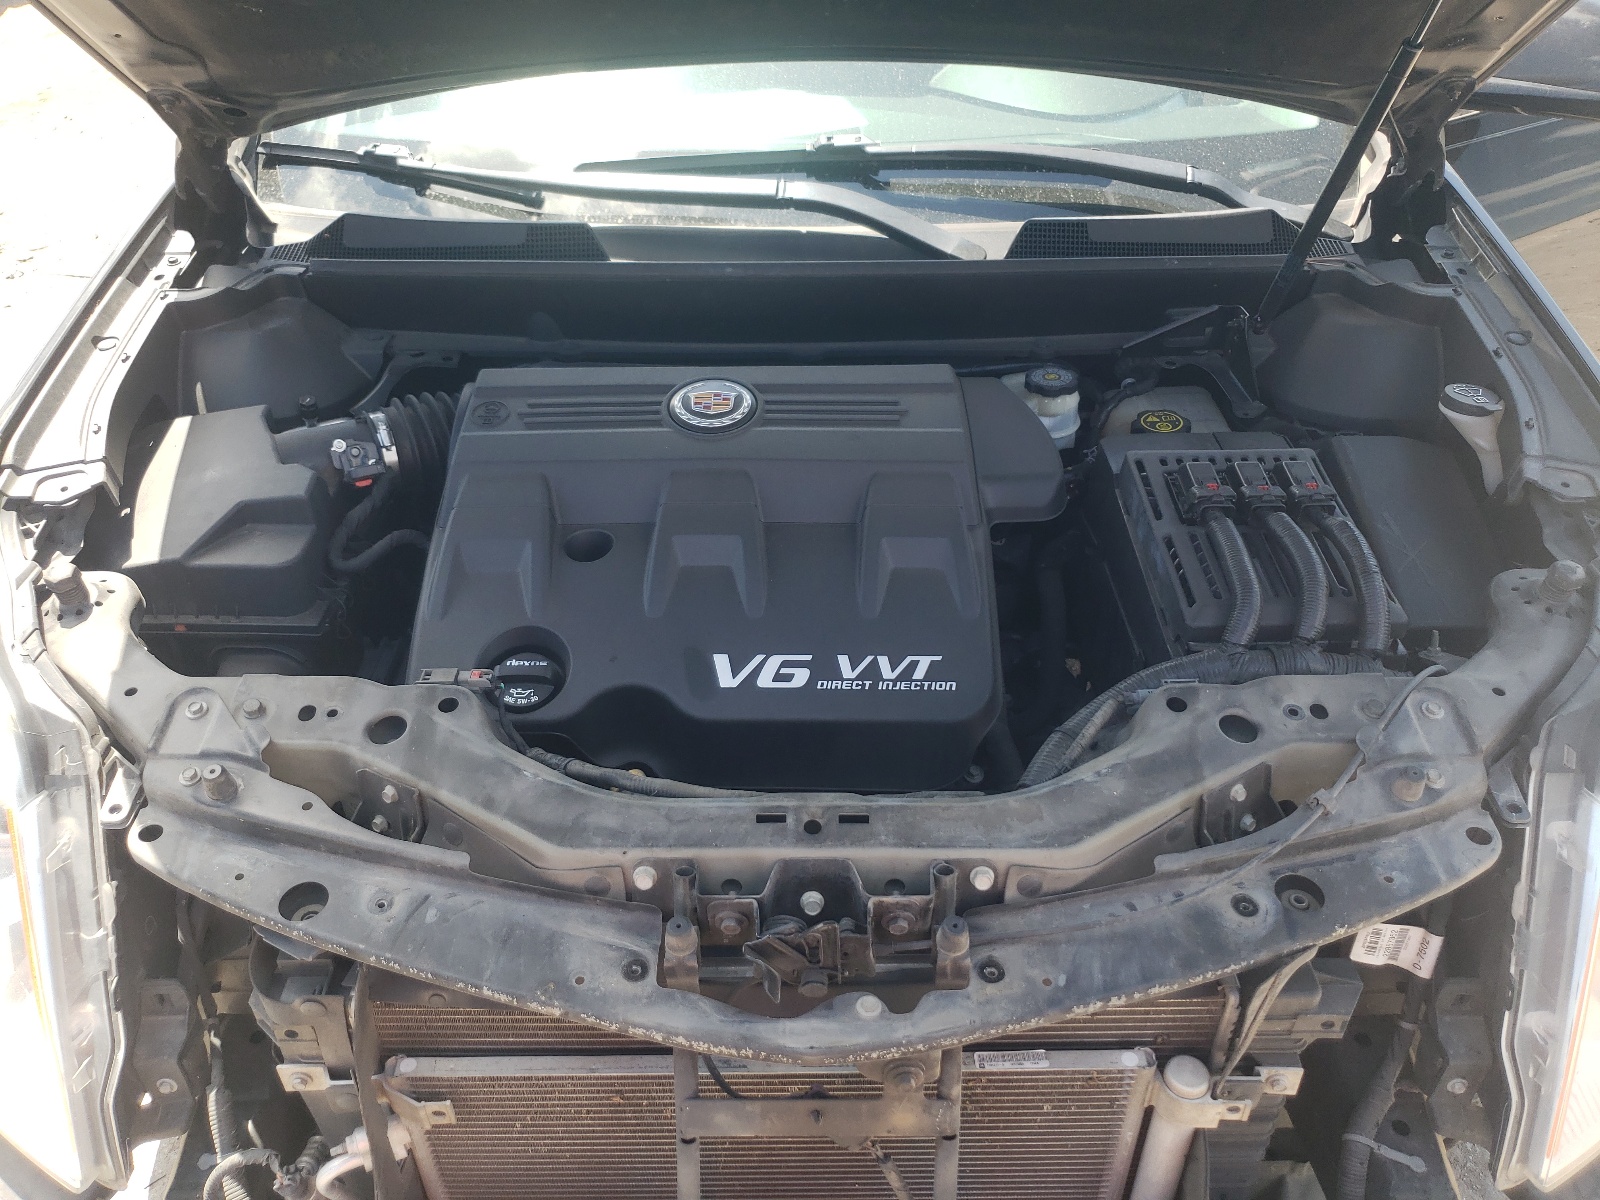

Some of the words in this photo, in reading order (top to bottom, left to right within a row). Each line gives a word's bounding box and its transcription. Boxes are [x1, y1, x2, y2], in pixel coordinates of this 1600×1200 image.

[713, 653, 813, 688] V6
[837, 654, 943, 679] VVT
[817, 680, 872, 690] DIRECT
[878, 681, 957, 691] INJECTION
[504, 695, 516, 704] SAE
[517, 695, 539, 704] 5W-30
